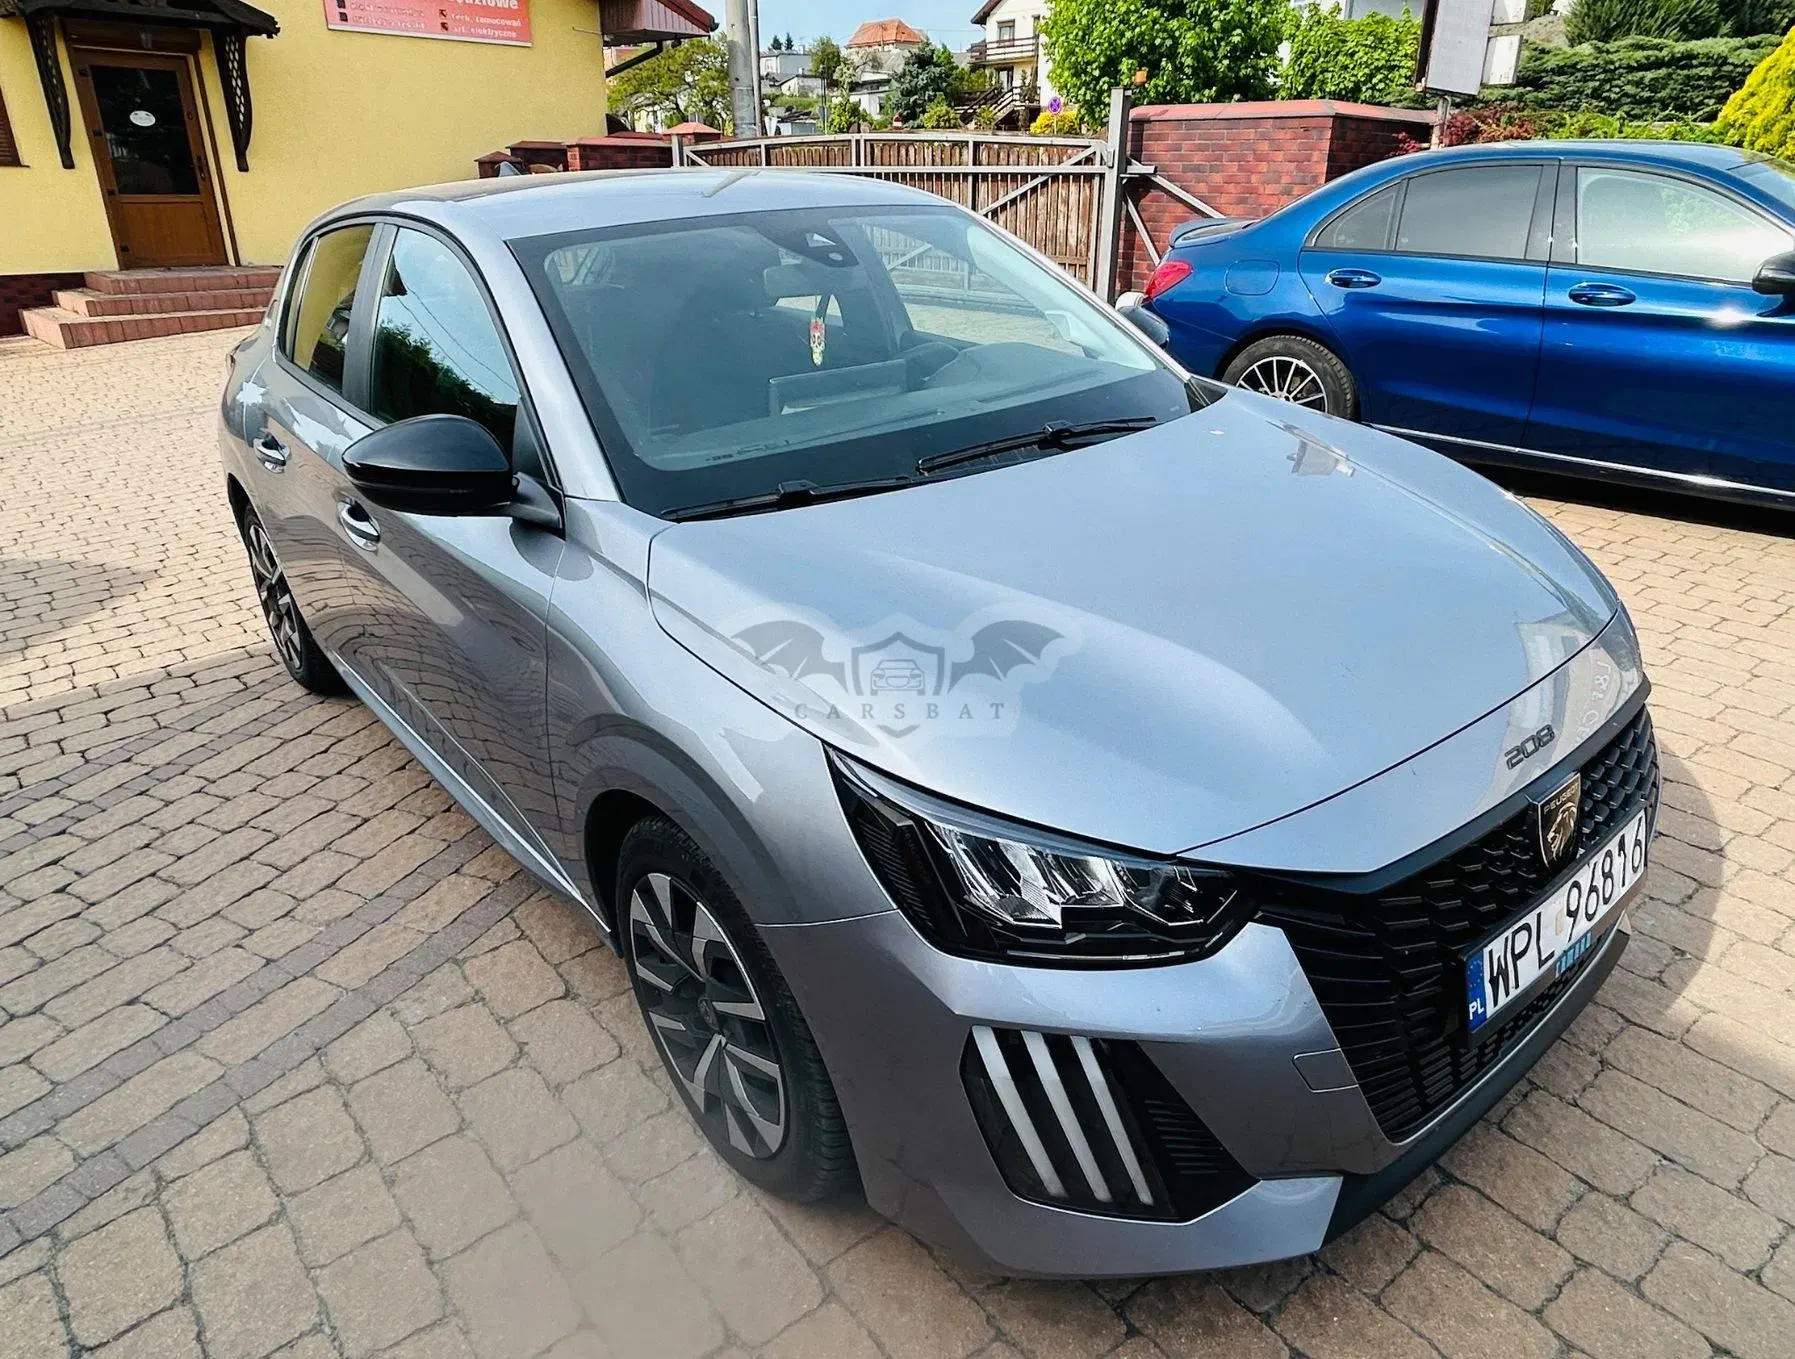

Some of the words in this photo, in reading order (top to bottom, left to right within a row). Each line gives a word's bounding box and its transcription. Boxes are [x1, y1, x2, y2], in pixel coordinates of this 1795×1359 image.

[1504, 723, 1556, 771] 208
[1543, 782, 1579, 815] PEUGEOT
[1488, 911, 1555, 1009] WPL
[1565, 816, 1643, 943] 96816
[1469, 999, 1485, 1021] PL
